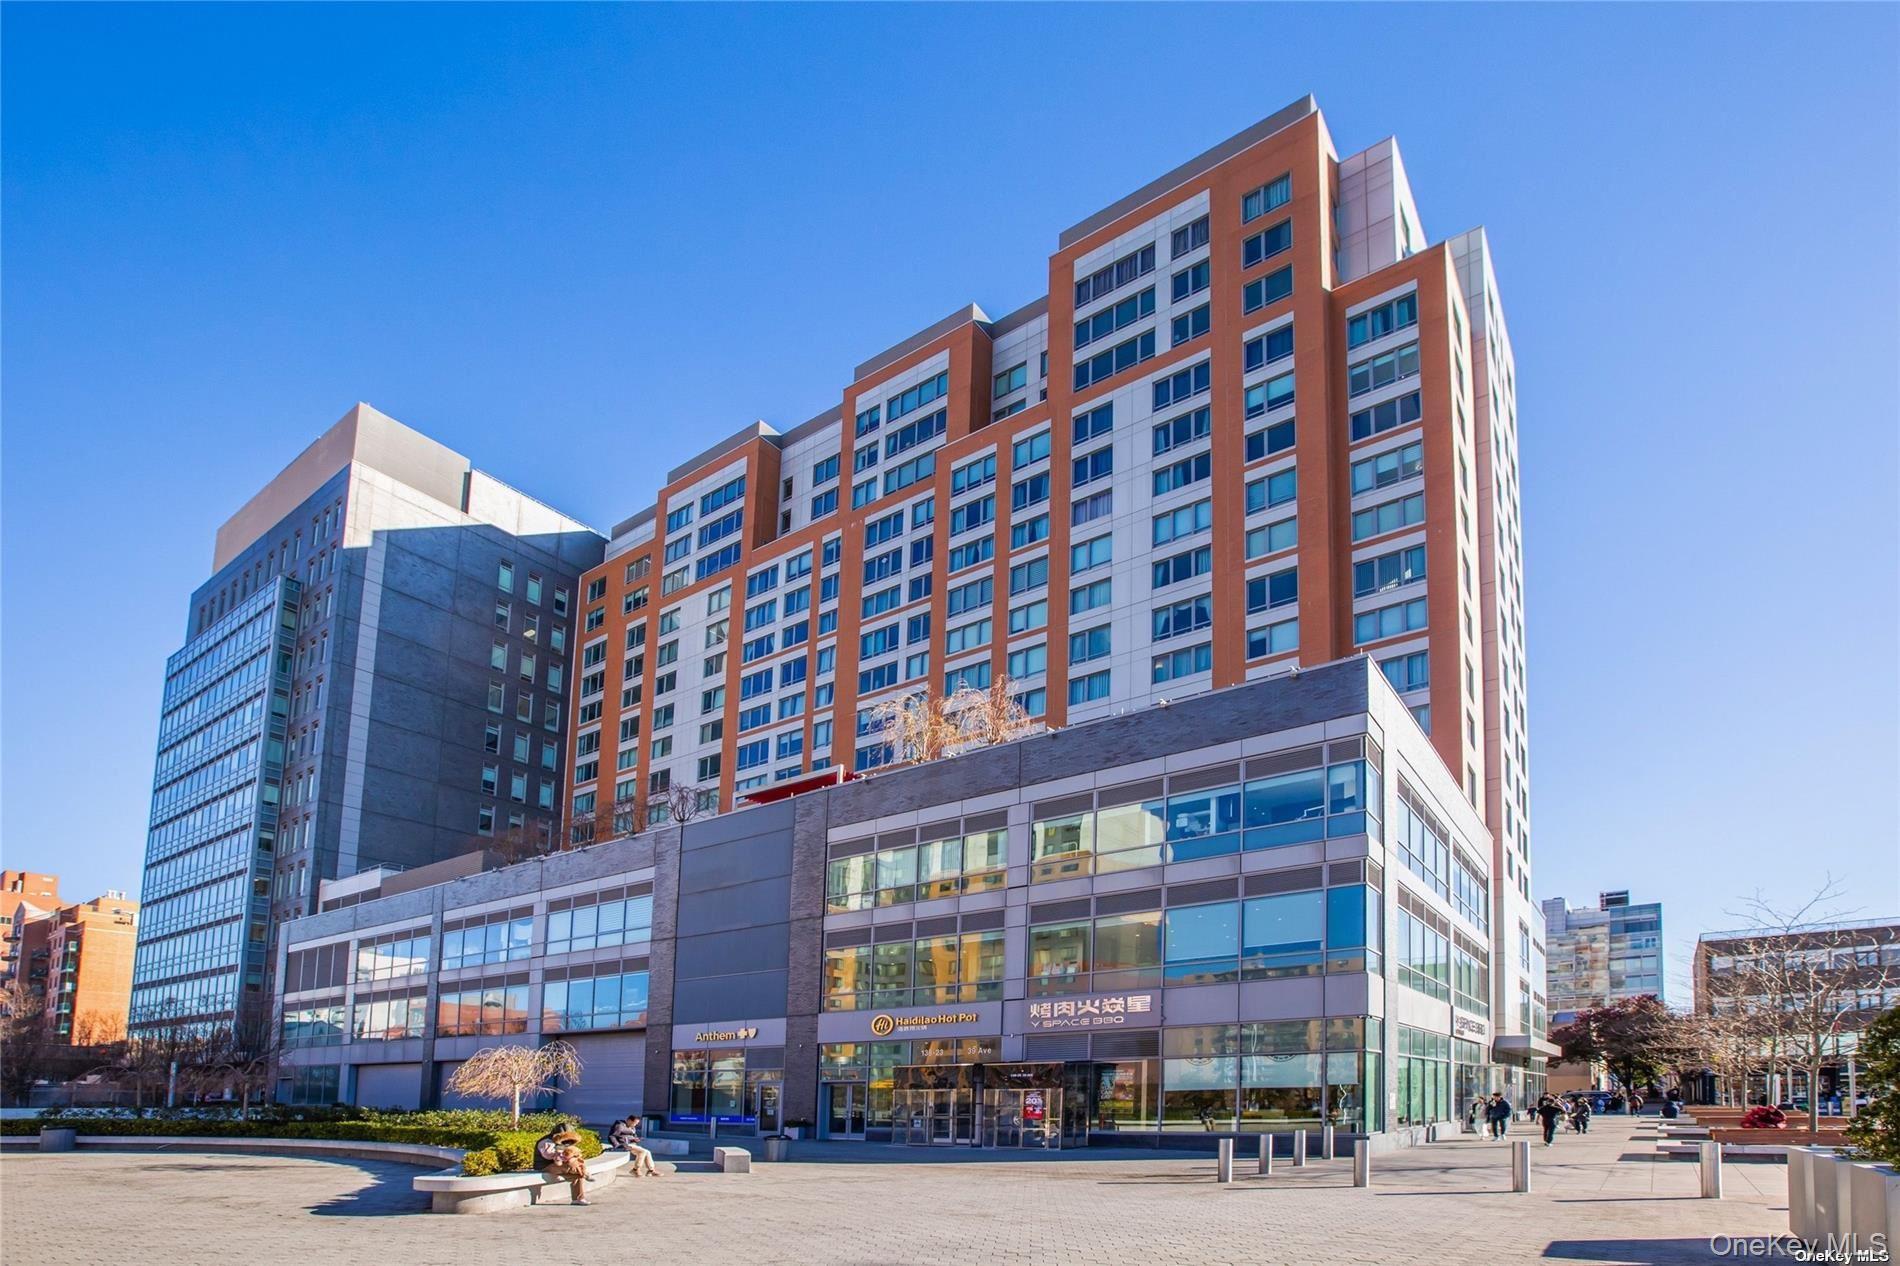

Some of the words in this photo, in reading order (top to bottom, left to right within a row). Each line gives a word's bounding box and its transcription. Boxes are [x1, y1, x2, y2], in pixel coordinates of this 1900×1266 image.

[896, 1016, 938, 1026] Haidilao
[938, 1014, 957, 1024] Hot
[959, 1013, 977, 1022] Pot
[1042, 1018, 1090, 1028] SPACE
[1093, 1016, 1124, 1025] BBQ
[695, 1031, 736, 1041] Anthem
[978, 1047, 992, 1055] Ave
